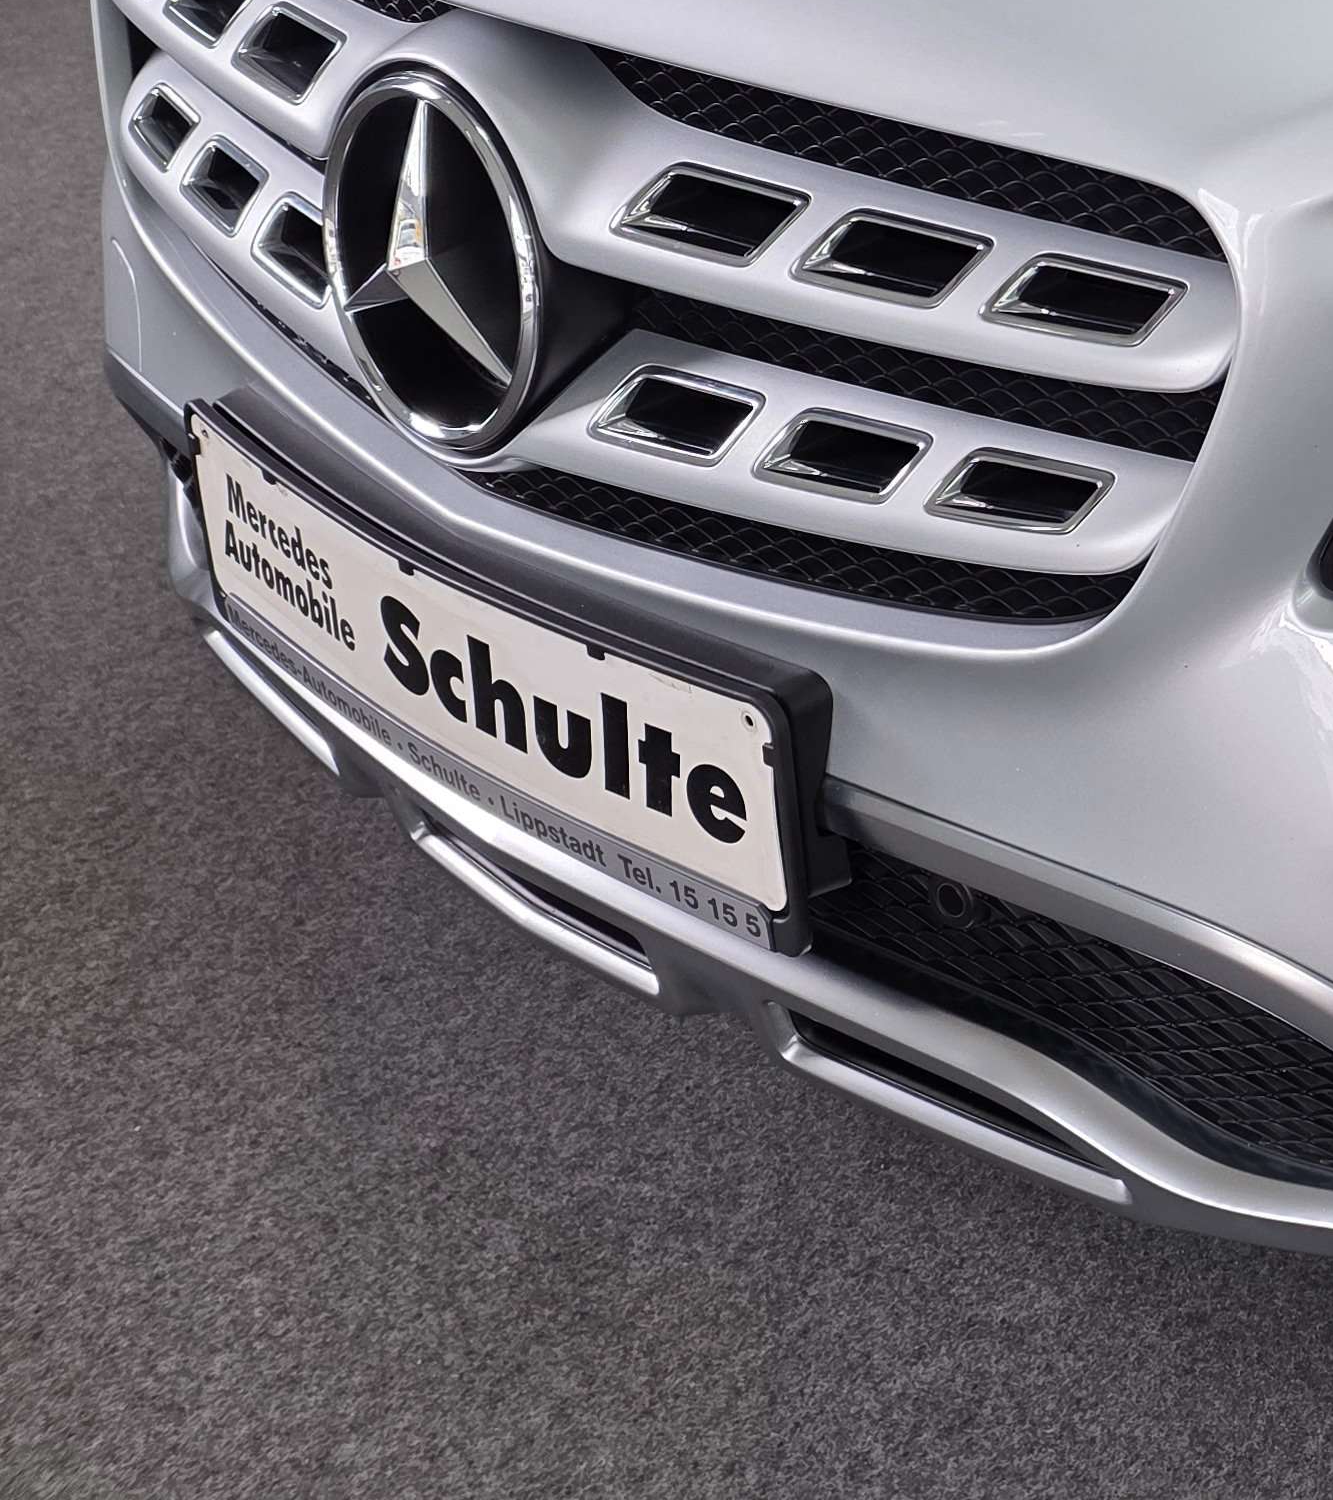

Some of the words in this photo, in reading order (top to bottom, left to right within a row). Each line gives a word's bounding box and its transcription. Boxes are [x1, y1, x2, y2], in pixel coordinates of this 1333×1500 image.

[224, 519, 356, 652] Automobile
[225, 472, 333, 590] Mercedes
[379, 595, 748, 845] Schulte
[406, 740, 482, 801] Schulte
[499, 795, 607, 868] Lippstadt
[617, 852, 663, 893] Tel.
[669, 879, 700, 910] 15
[707, 897, 738, 928] 15
[745, 912, 761, 938] 5
